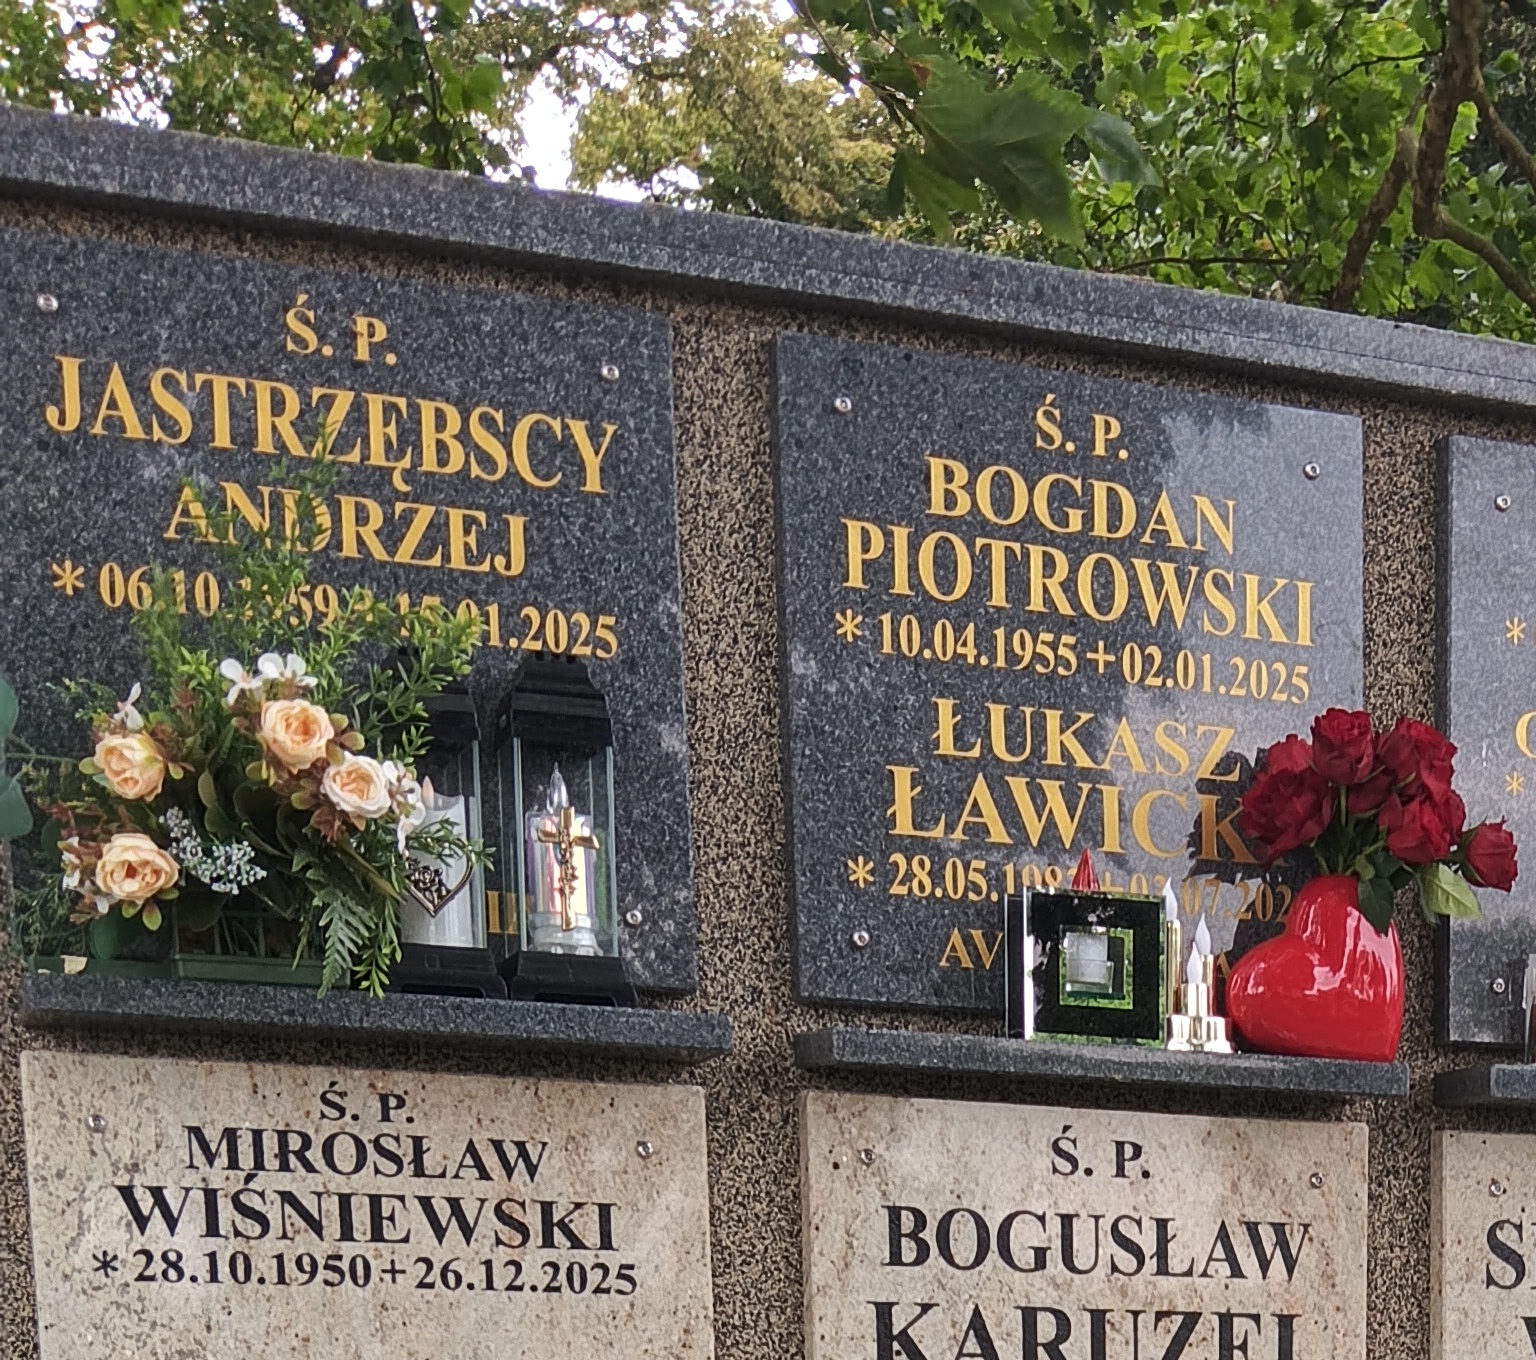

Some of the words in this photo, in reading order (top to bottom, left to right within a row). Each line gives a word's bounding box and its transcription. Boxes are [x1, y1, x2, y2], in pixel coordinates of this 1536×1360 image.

[285, 295, 333, 357] Ś.
[353, 316, 397, 364] P.
[46, 355, 618, 494] JASTRZĘBSCY
[1036, 395, 1074, 452] Ś.
[1092, 414, 1128, 460] P.
[164, 481, 530, 576] ANDRZEJ
[925, 456, 1236, 554] BOGDAN
[841, 518, 1315, 647] PIOTROWSKI
[933, 698, 1240, 782] ŁUKASZ
[886, 765, 1289, 867] ŁAWICK
[319, 1081, 360, 1122] Ś.
[379, 1092, 415, 1124] P.
[184, 1125, 548, 1183] MIROSŁAW
[1051, 1125, 1093, 1177] Ś.
[1113, 1138, 1151, 1179] P.
[115, 1173, 619, 1251] WIŚNIEWSKI
[882, 1204, 1312, 1282] BOGUSŁAW
